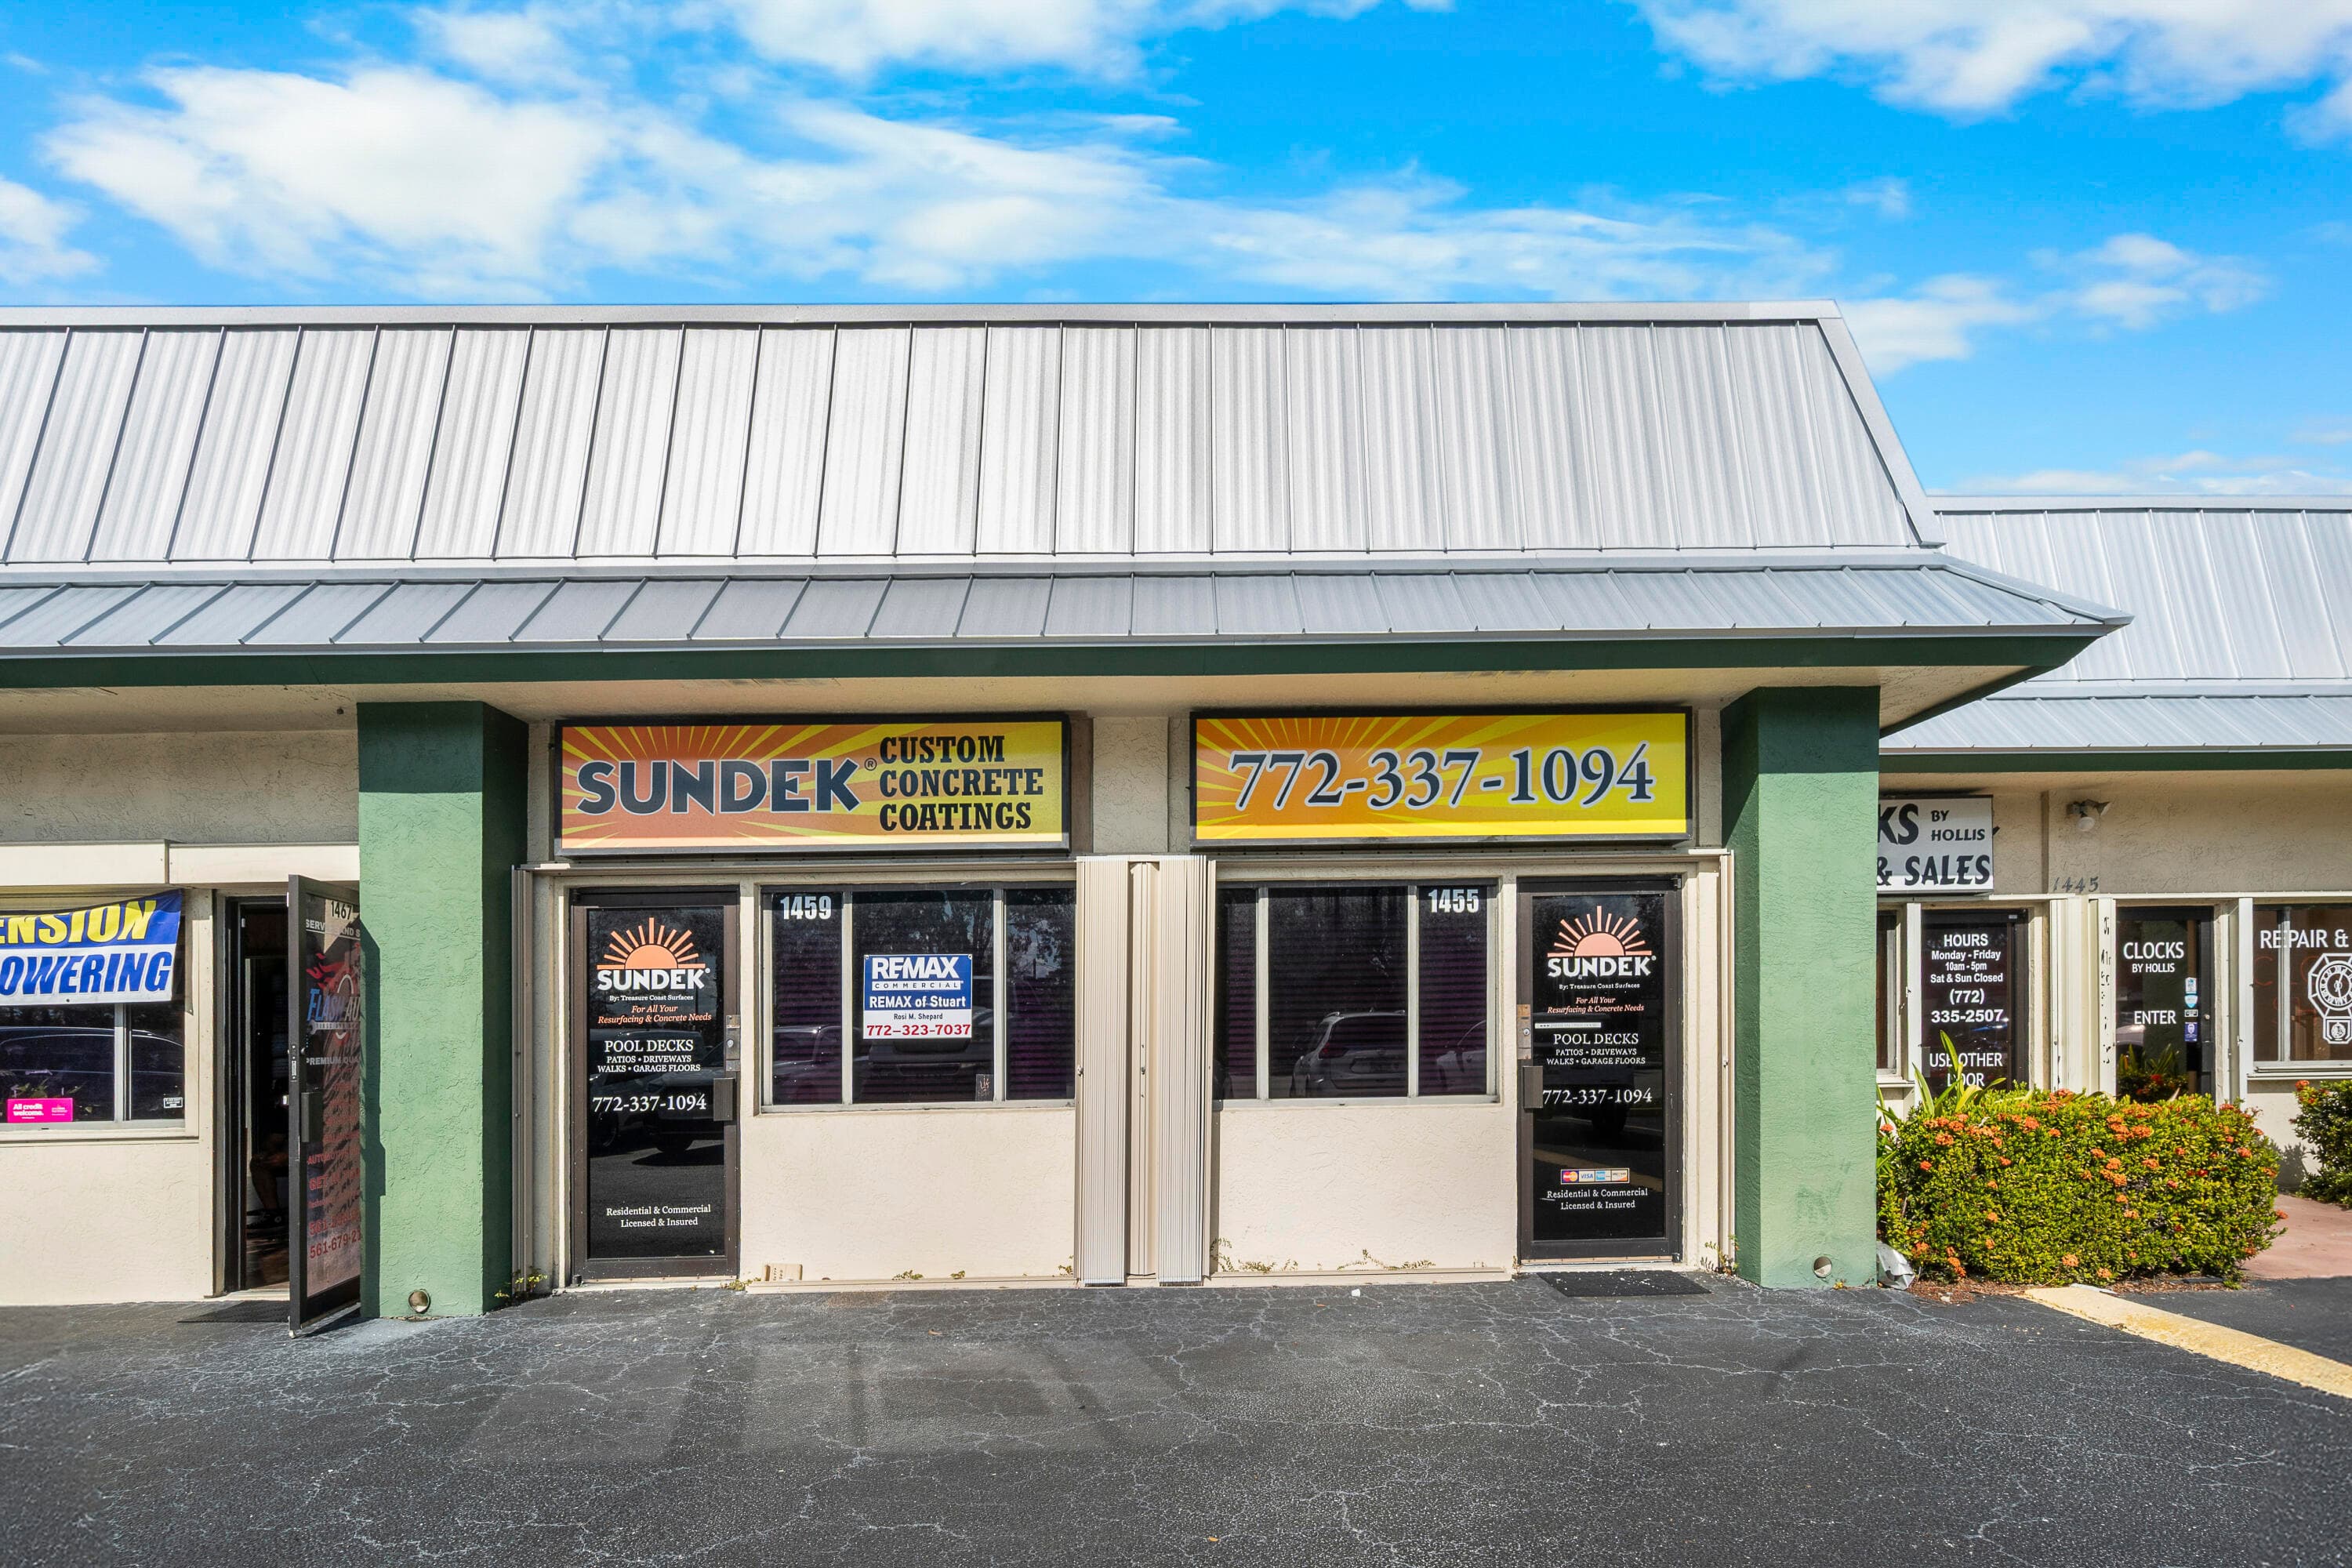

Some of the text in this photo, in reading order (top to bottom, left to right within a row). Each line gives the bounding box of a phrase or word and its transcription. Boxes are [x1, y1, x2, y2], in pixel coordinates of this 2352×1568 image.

[880, 735, 1004, 764] CUSTOM
[1228, 740, 1656, 810] 772-337-1094
[880, 768, 1043, 797] CONCRETE
[880, 802, 1031, 831] COATINGS
[1931, 810, 1950, 822] BY
[1931, 829, 1985, 841] HOLLIS
[1904, 855, 1990, 886] SALES
[2053, 877, 2099, 891] 1445
[780, 895, 832, 920] 1459
[1428, 889, 1479, 913] 1455
[331, 901, 352, 920] 1467
[1944, 934, 1989, 947] HOURS
[2260, 929, 2350, 949] REPAIR &
[1932, 950, 1966, 961] Monday
[1973, 949, 2001, 960] Friday
[2123, 942, 2184, 960] CLOCKS
[872, 956, 960, 979] REMAX
[1945, 962, 1965, 971] 10am
[1971, 961, 1987, 972] 5pm
[2132, 963, 2175, 973] BY HOLLIS
[1930, 973, 2003, 983] Sat & Sun Closed
[869, 996, 966, 1008] REMAX of Stuart
[1950, 988, 1985, 1005] (772)
[631, 1005, 645, 1014] For
[659, 1004, 678, 1013] Your
[1548, 1006, 1586, 1015] Resurfacing
[597, 1015, 644, 1025] Resurfacing
[653, 1014, 688, 1022] Concrete
[689, 1012, 712, 1021] Needs
[1931, 1009, 2004, 1023] 335-2507
[2134, 1011, 2176, 1024] ENTER
[866, 1024, 971, 1036] 772-323-7037
[1553, 1033, 1639, 1045] POOL DECKS
[604, 1040, 694, 1053] POOL DECKS
[1958, 1053, 2003, 1067] OTHER
[1543, 1087, 1653, 1105] 772-337-1094
[593, 1094, 706, 1112] 772-337-1094
[1547, 1189, 1591, 1199] Residential
[1601, 1188, 1648, 1196] Commercial
[607, 1204, 711, 1215] Residential & Commercial
[1561, 1201, 1595, 1210] Licensed
[1606, 1200, 1635, 1209] Insured
[621, 1218, 656, 1228] Licensed
[666, 1217, 698, 1225] Insured
